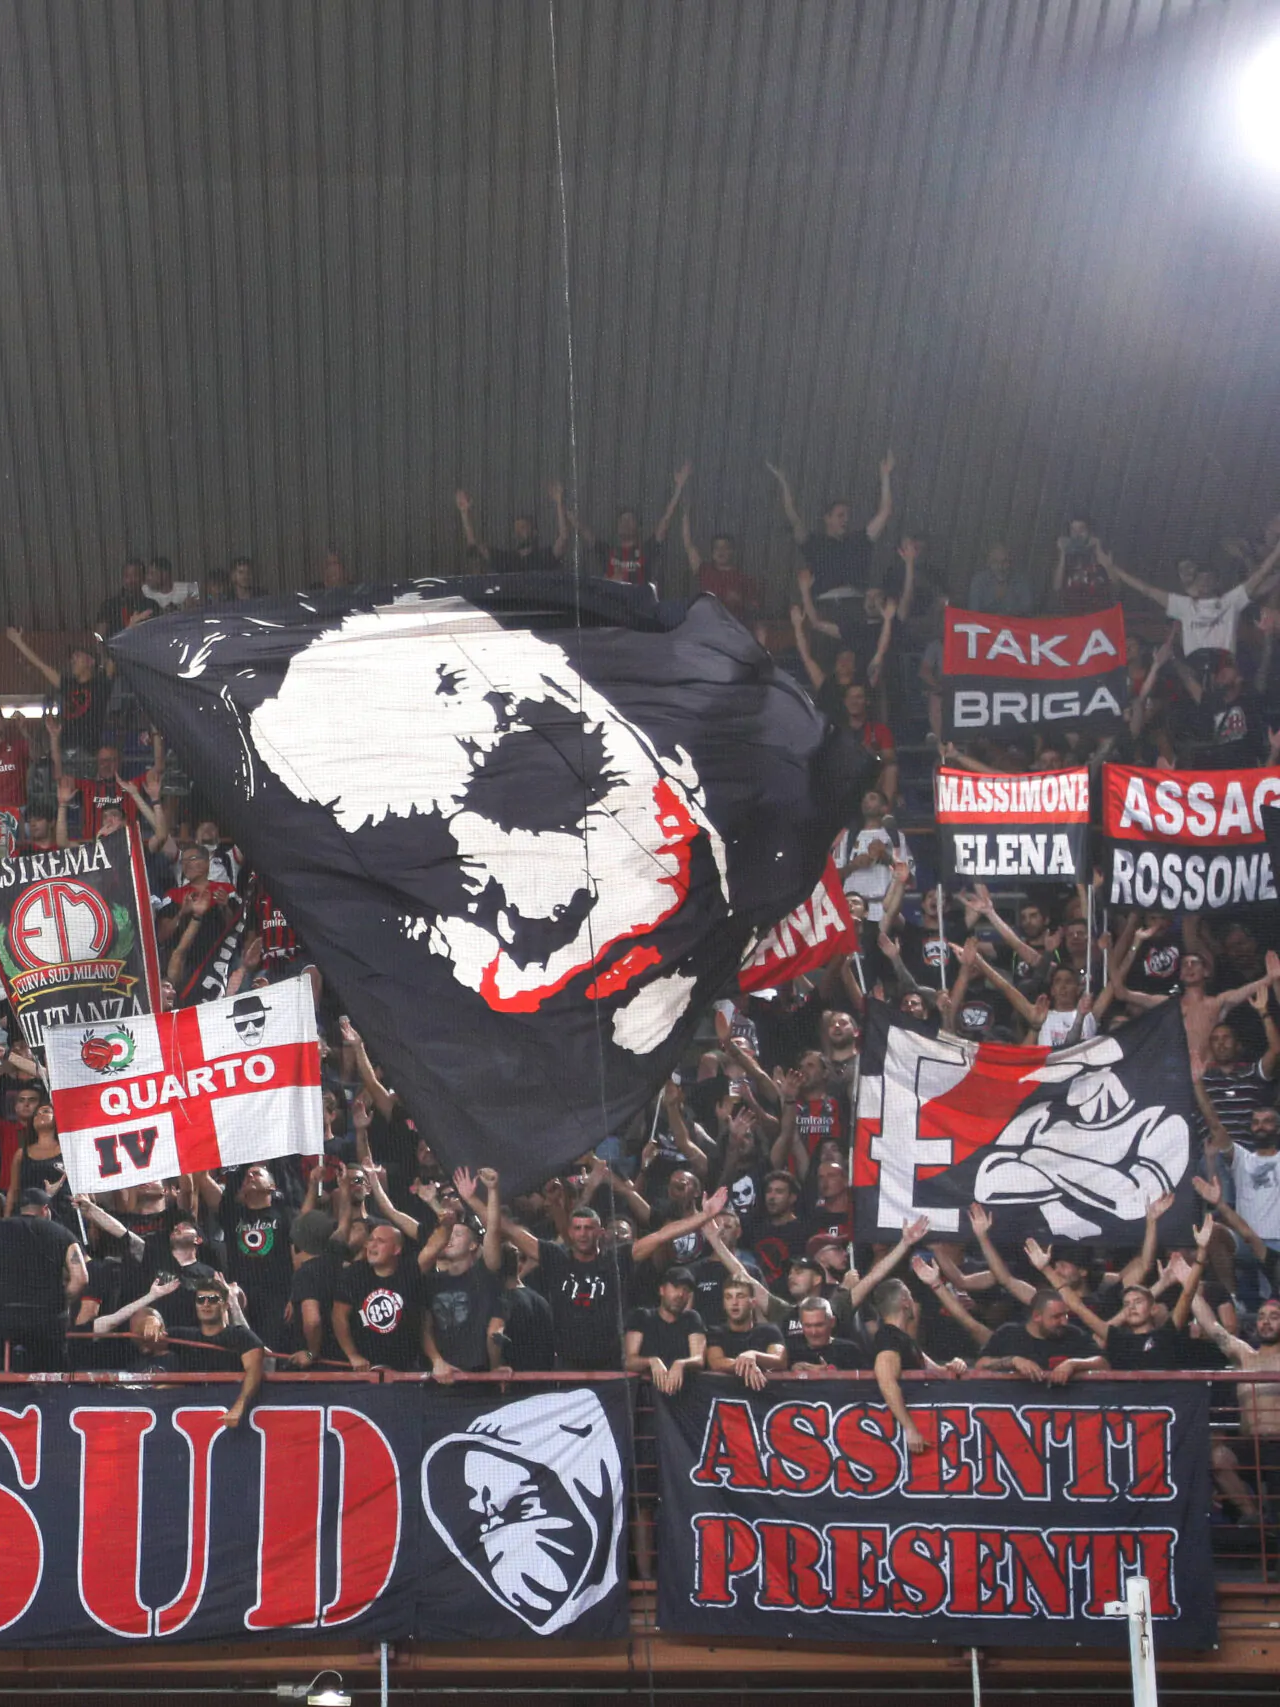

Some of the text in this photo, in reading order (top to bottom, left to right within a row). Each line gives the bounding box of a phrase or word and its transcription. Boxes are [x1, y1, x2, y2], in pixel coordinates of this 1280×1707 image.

[953, 623, 1117, 667] TAKA
[953, 686, 1122, 728] BRIGA
[936, 773, 1089, 813] MASSIMONE
[953, 833, 1076, 876] ELENA
[16, 962, 118, 995] CURVA SUD MILANO
[100, 1054, 276, 1116] QUARTO
[94, 1125, 160, 1179] IV
[689, 1397, 1179, 1504] ASSENTI
[689, 1510, 1182, 1622] PRESENTI
